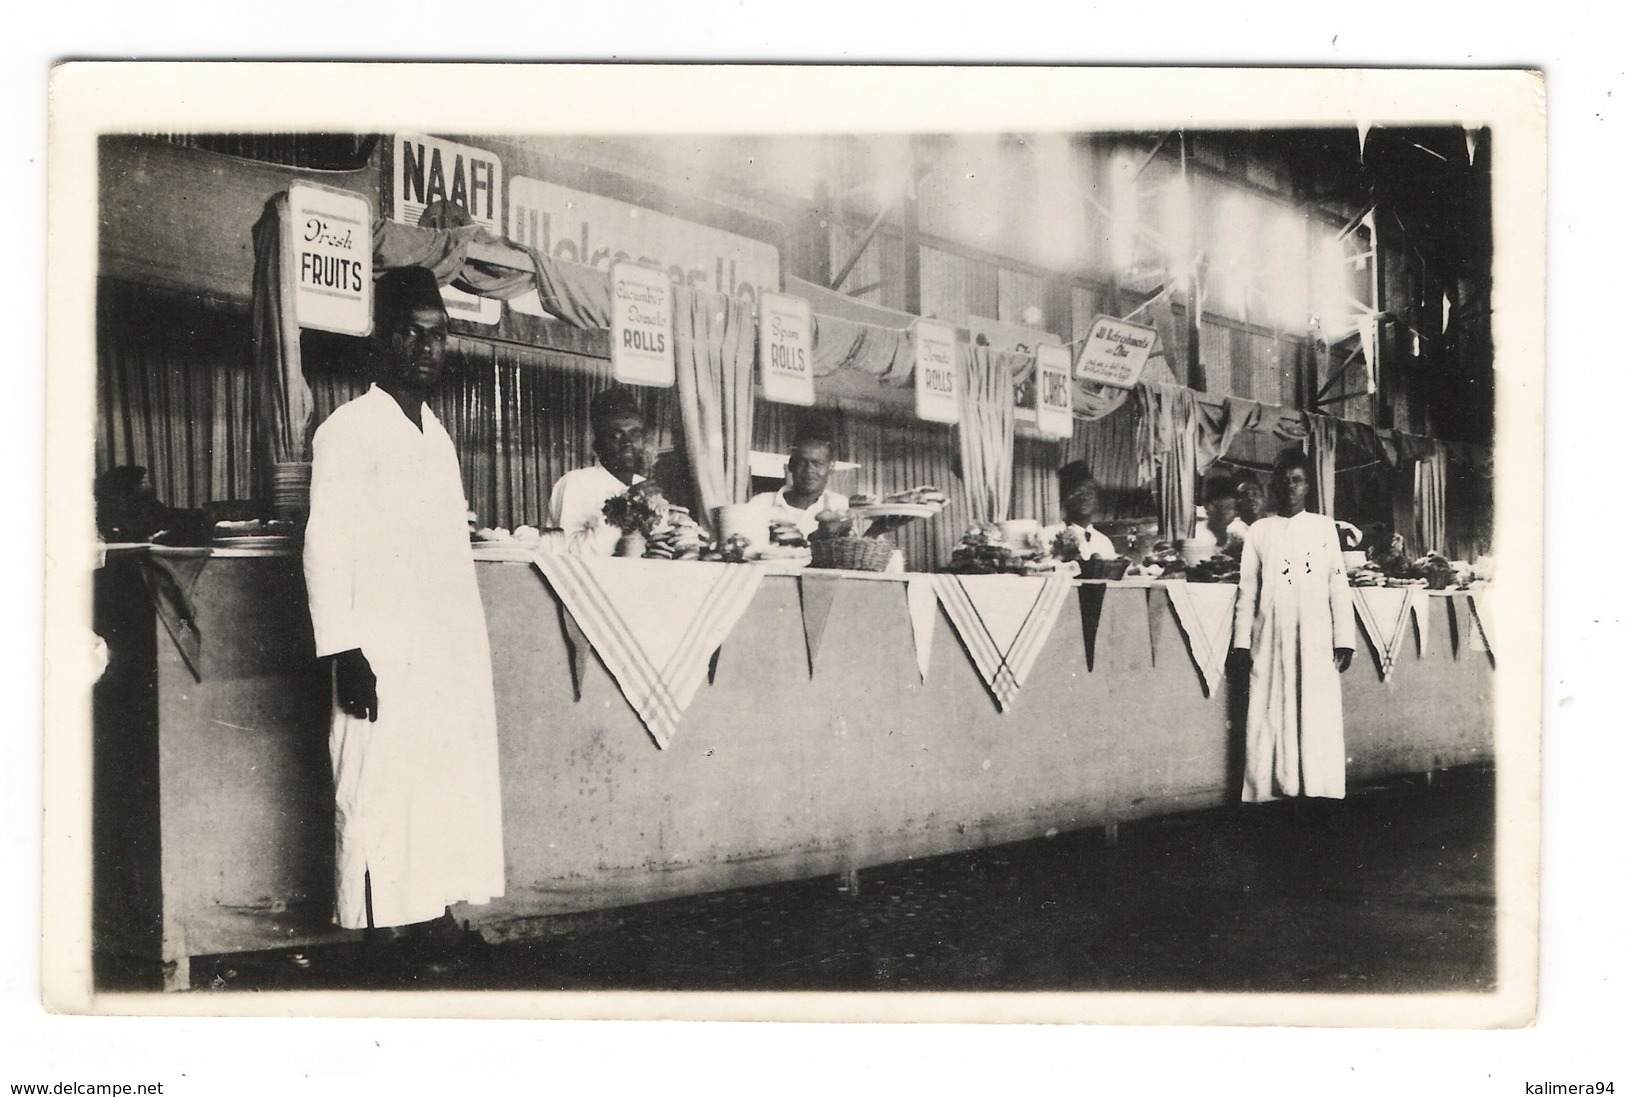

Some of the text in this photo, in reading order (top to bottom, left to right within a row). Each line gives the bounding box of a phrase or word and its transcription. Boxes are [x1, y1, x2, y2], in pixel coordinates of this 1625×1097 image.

[403, 140, 494, 220] NAAFI
[304, 218, 353, 250] Fresh
[301, 252, 362, 292] FRUITS
[623, 328, 665, 353] ROLLS
[771, 316, 799, 342] Spam
[771, 343, 805, 372] ROLLS
[925, 368, 952, 393] ROLLS
